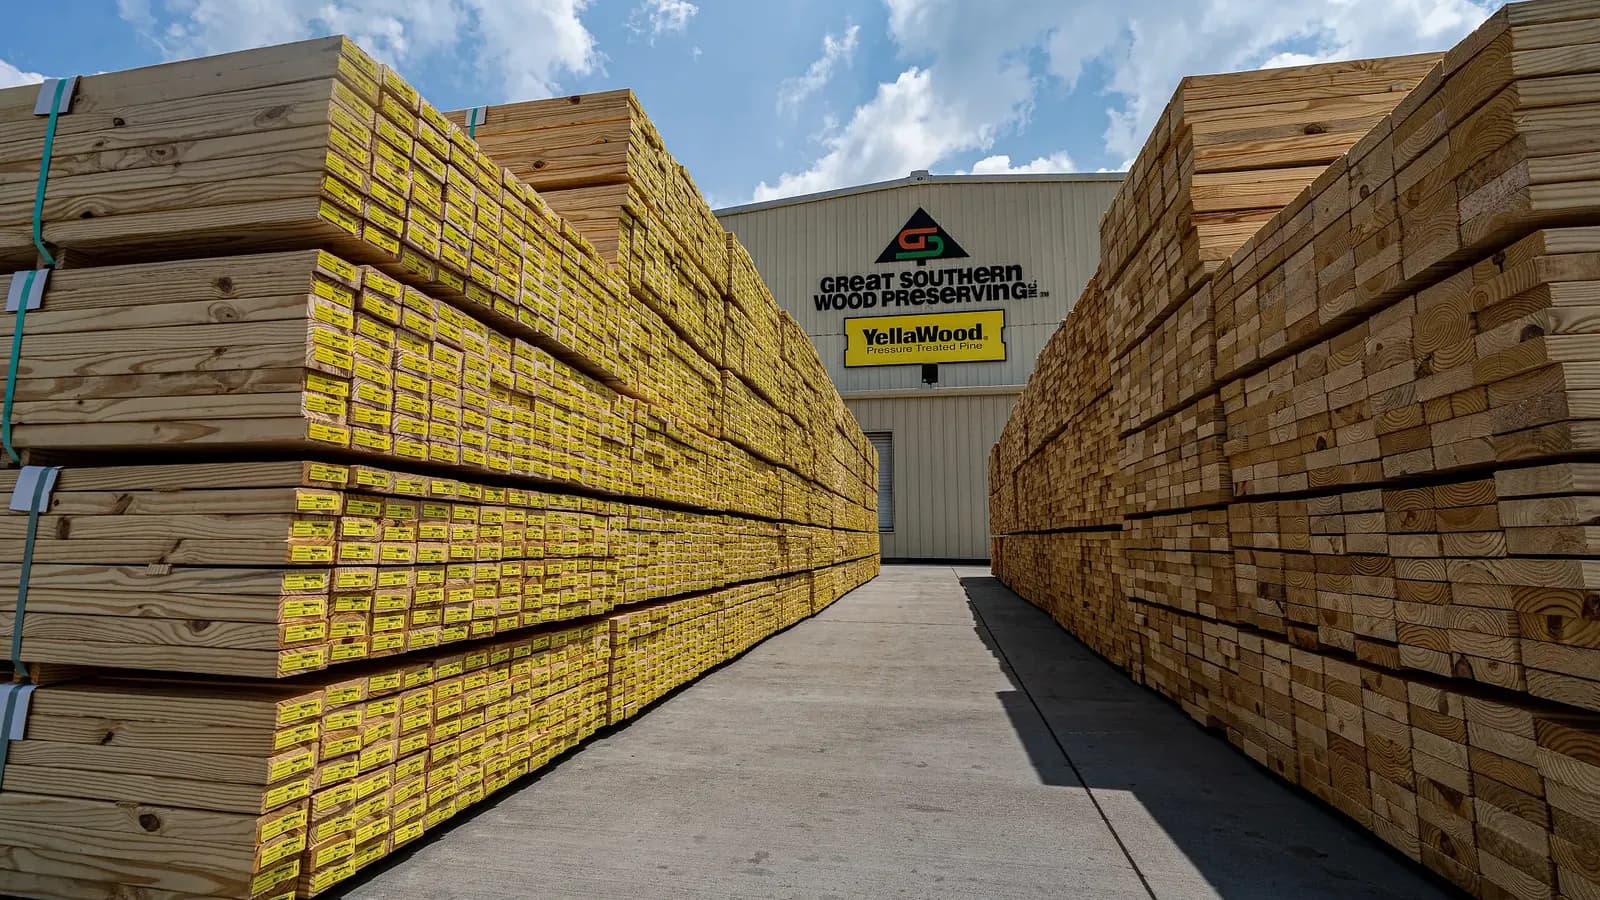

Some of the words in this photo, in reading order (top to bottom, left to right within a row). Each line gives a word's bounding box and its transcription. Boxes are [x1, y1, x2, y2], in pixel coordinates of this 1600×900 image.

[813, 291, 877, 311] WOOD
[866, 346, 912, 354] Pressure
[917, 344, 956, 352] Treated
[959, 341, 983, 350] Pine
